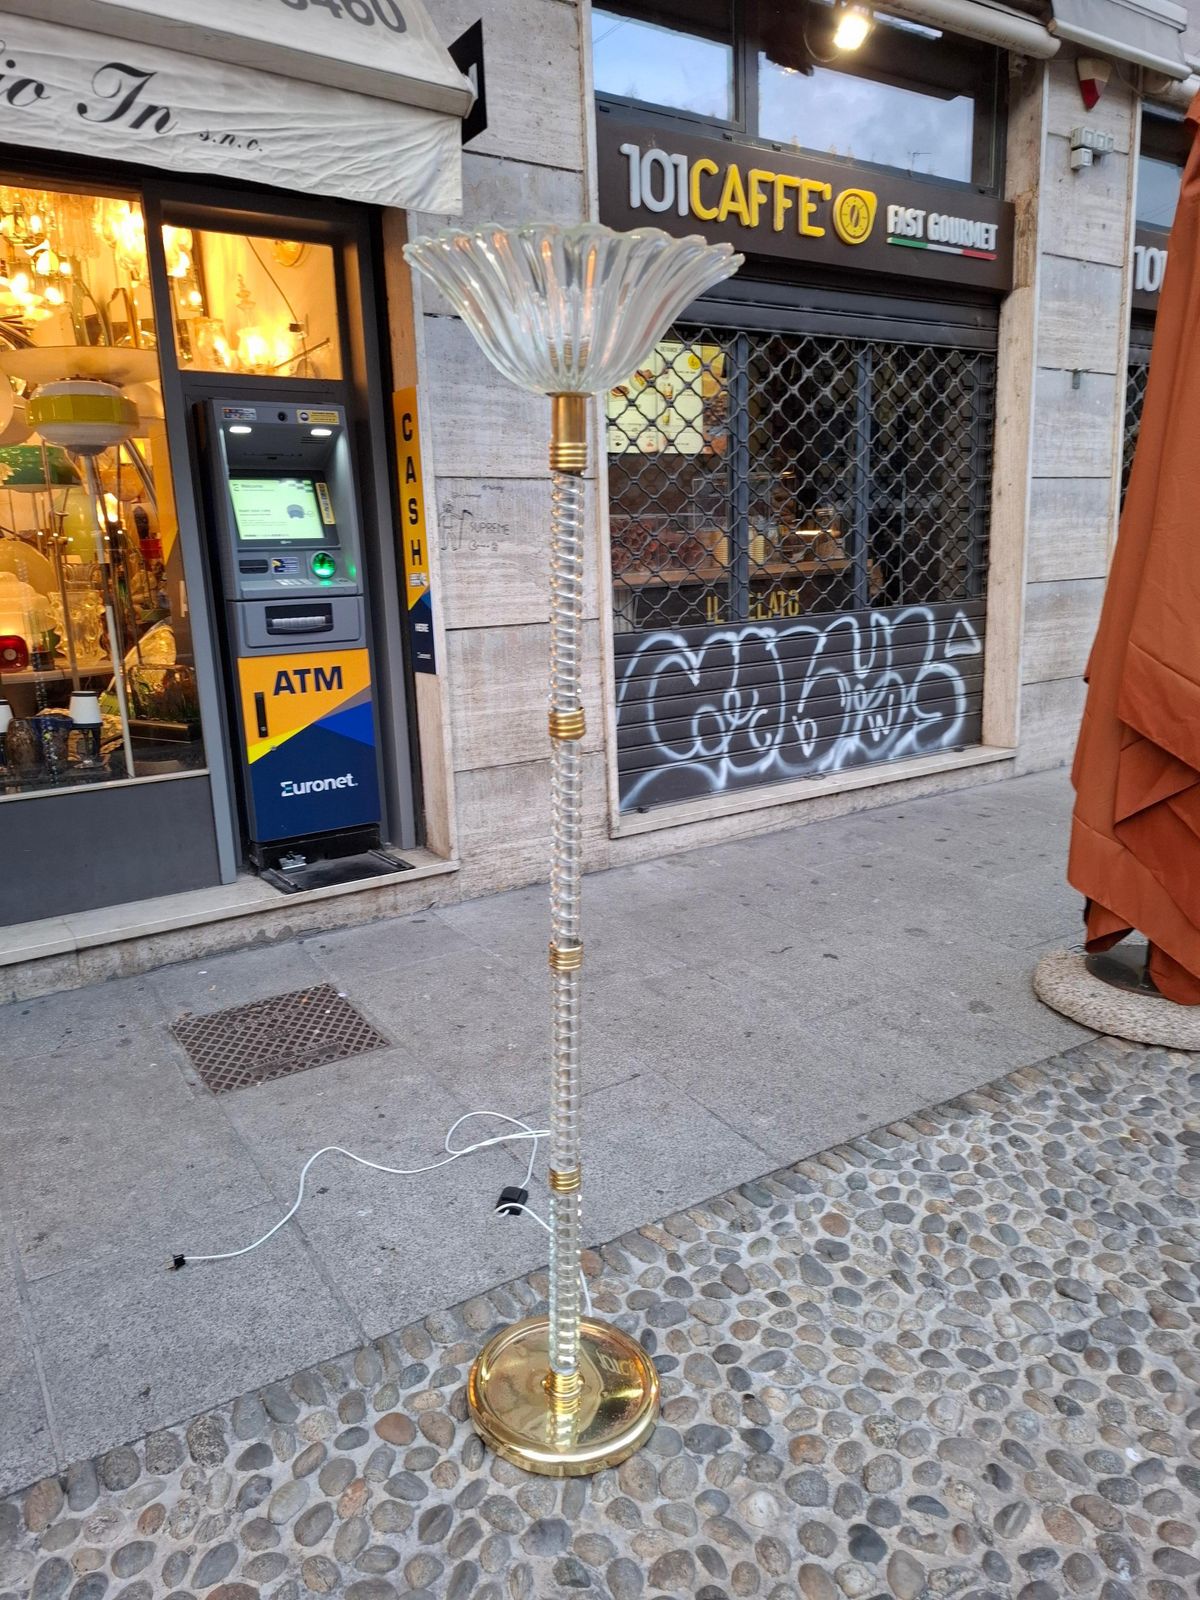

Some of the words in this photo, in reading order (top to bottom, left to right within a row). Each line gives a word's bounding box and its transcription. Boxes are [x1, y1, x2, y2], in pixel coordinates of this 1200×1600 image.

[76, 61, 178, 135] In
[200, 128, 263, 151] s.n.c.
[927, 212, 999, 250] GOURMET
[402, 412, 423, 566] CASH
[748, 589, 800, 619] ELATO
[273, 666, 343, 696] ATM
[280, 773, 355, 797] Euronet
